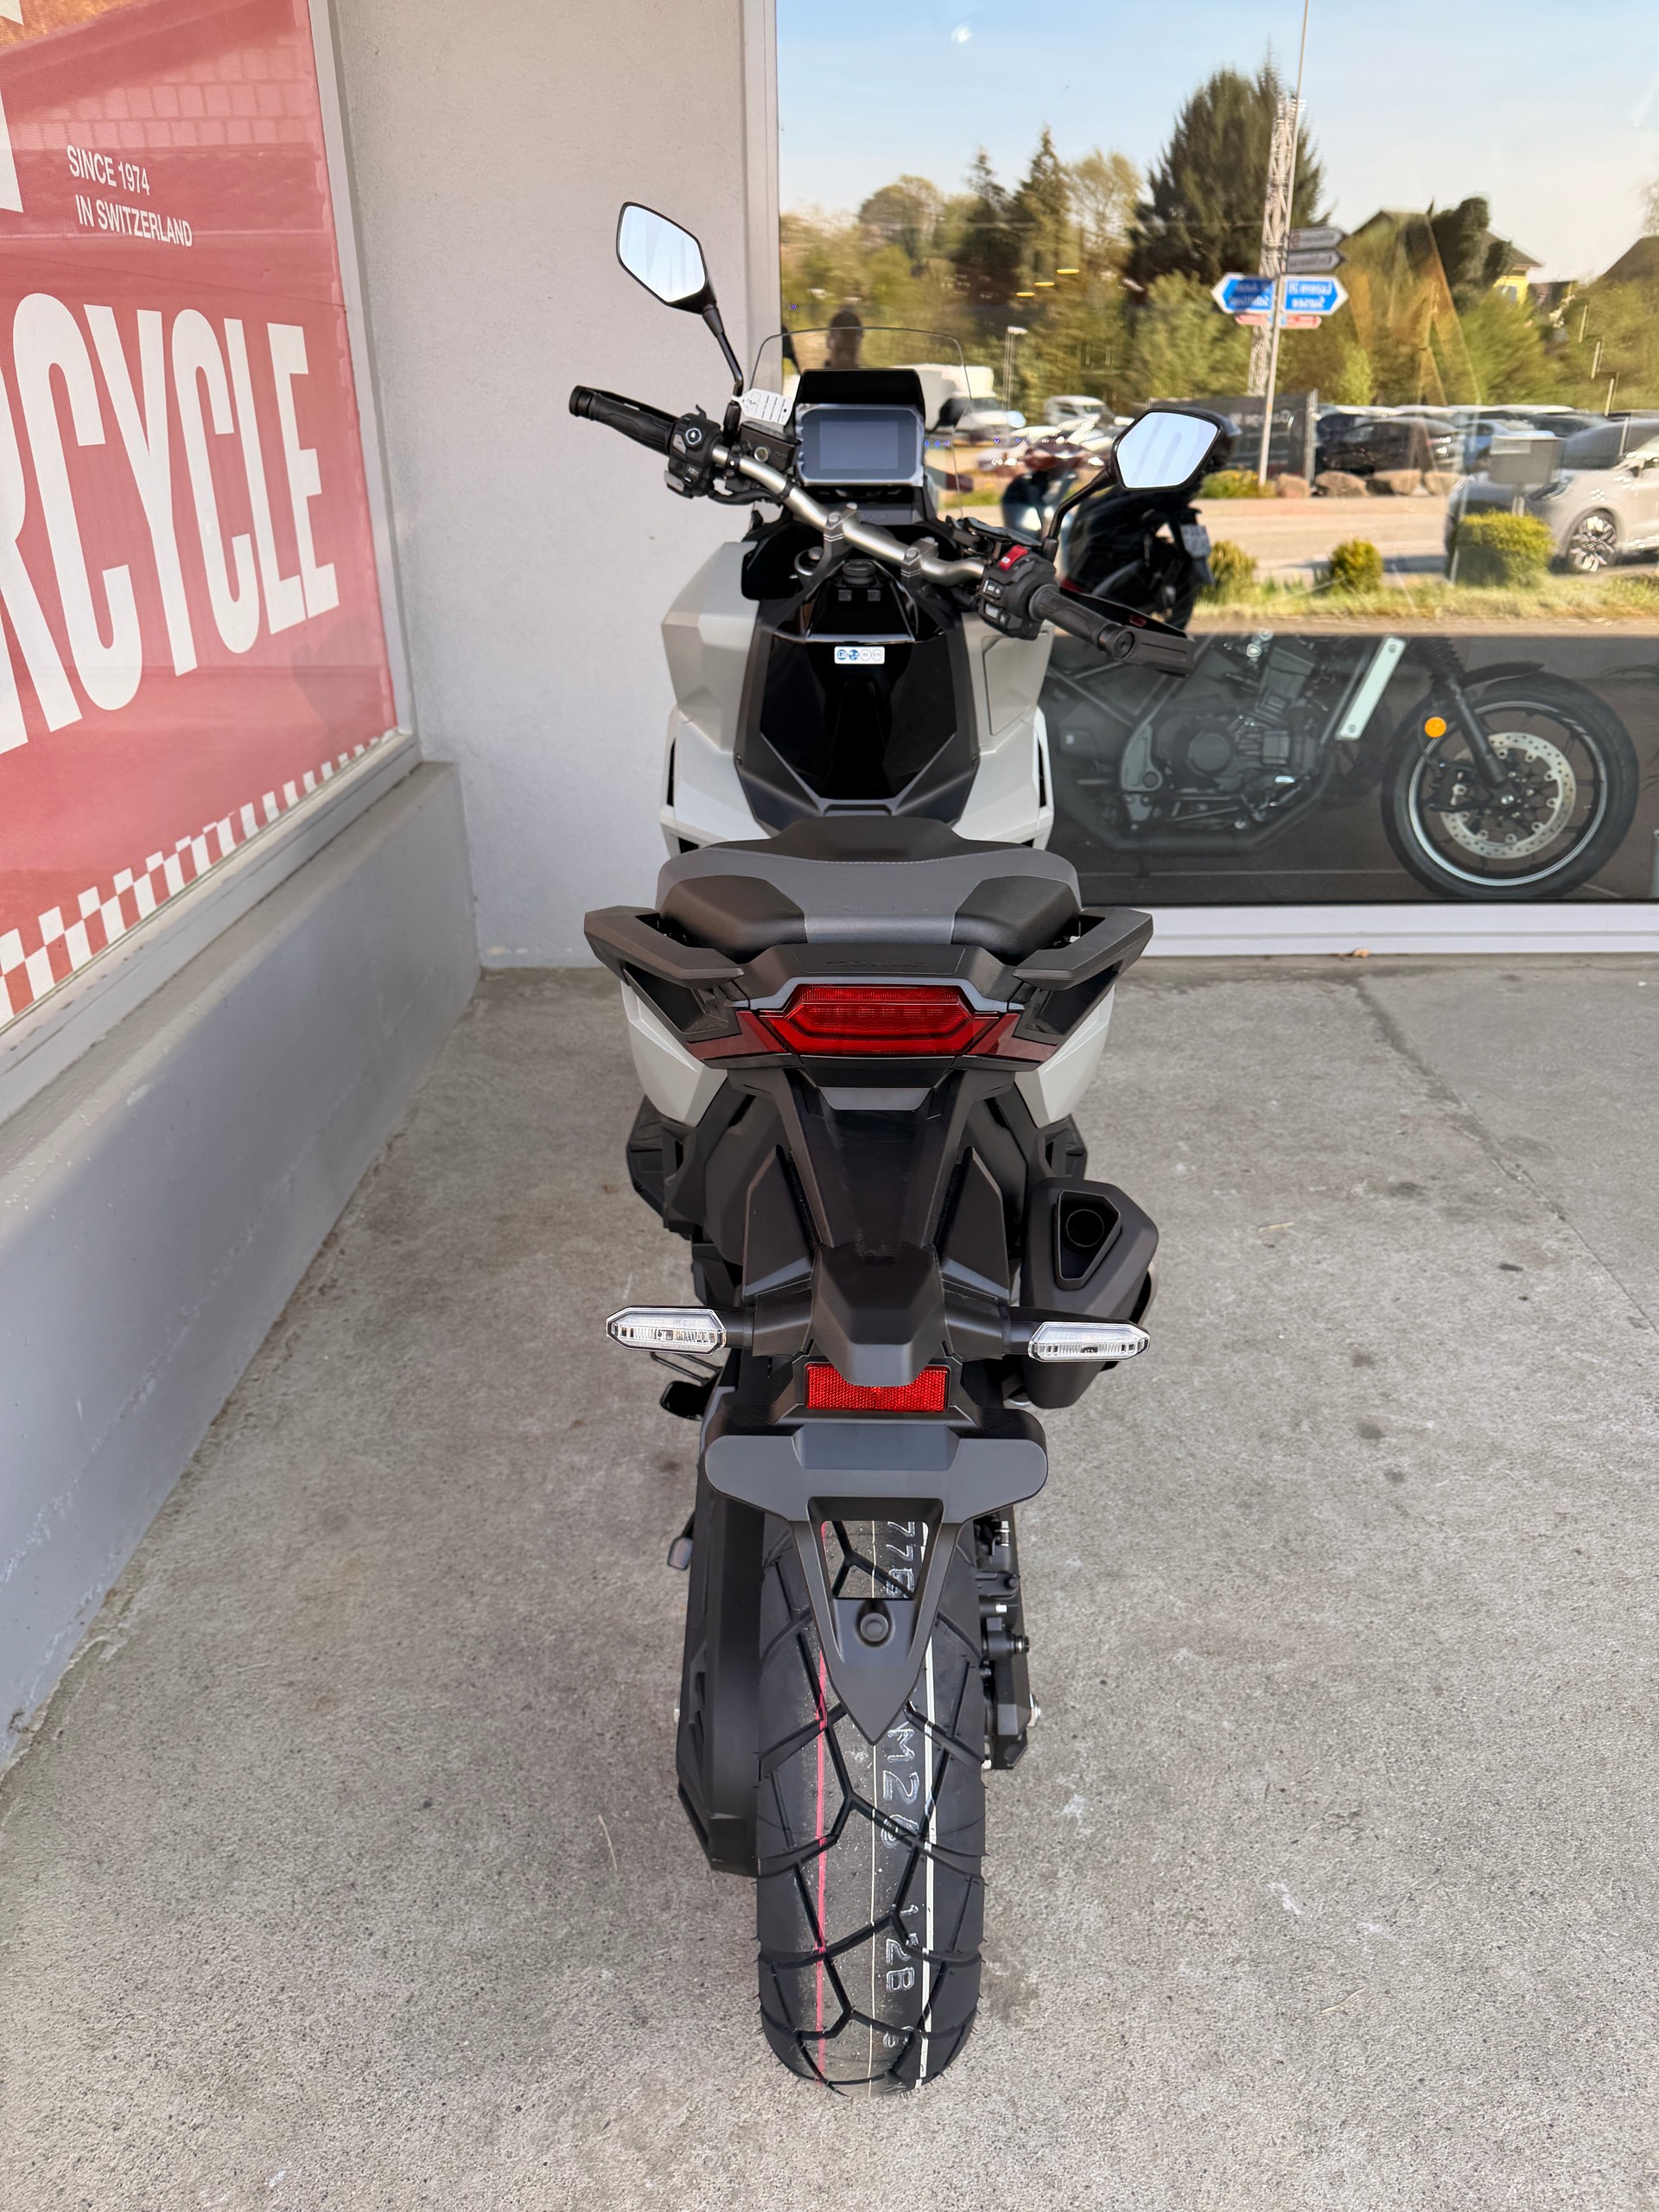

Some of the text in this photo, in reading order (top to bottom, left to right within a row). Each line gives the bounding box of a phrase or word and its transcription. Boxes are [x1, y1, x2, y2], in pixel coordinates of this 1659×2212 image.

[67, 144, 150, 196] SINCE 1974
[74, 194, 193, 247] IN SWITZERLAND
